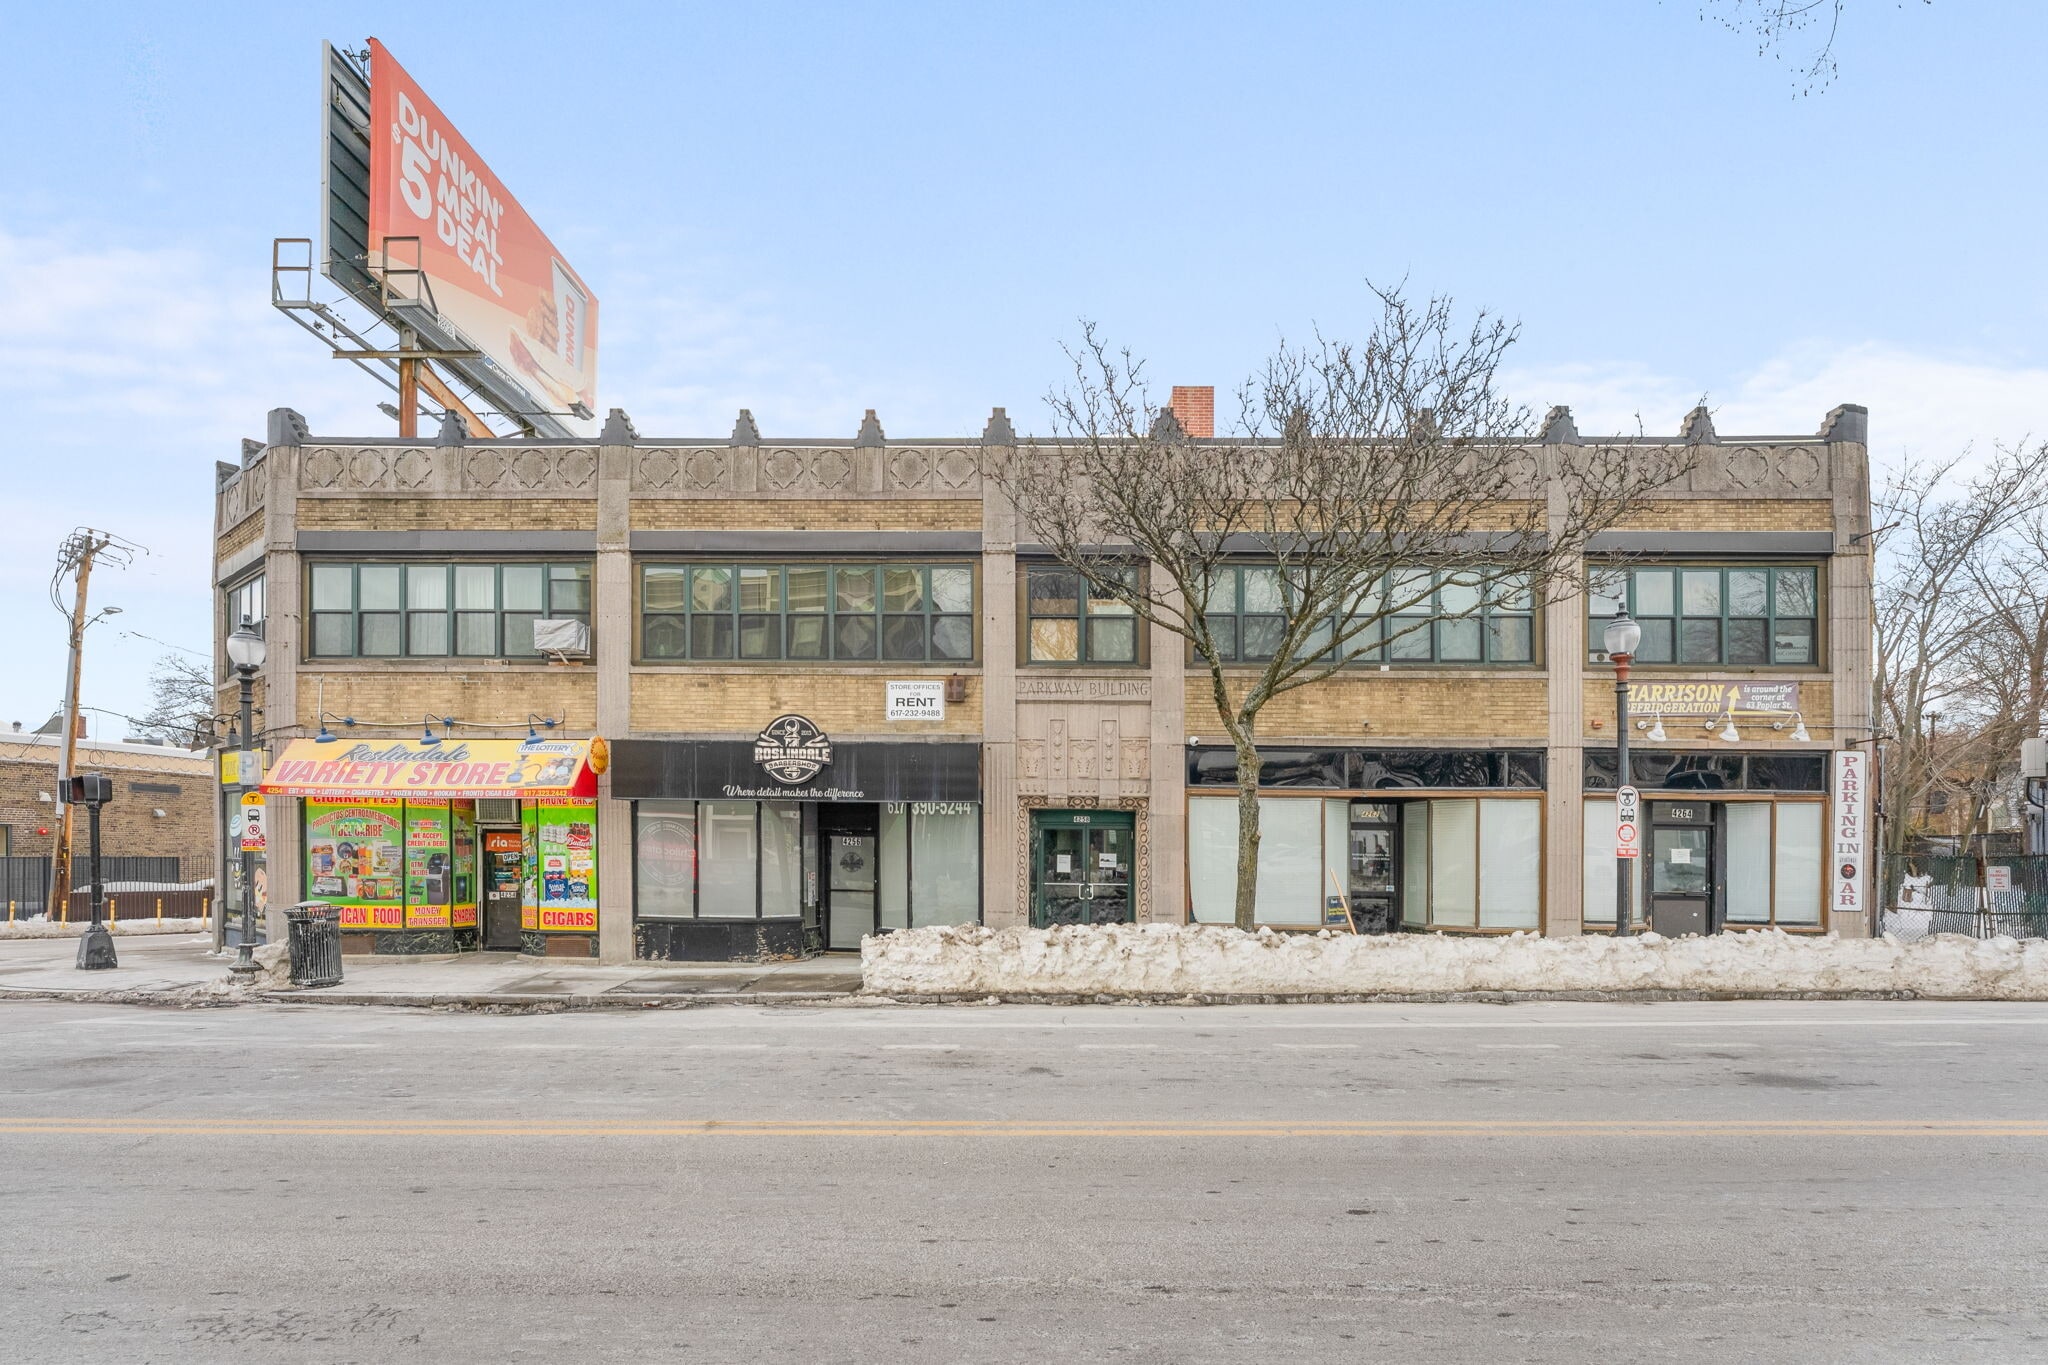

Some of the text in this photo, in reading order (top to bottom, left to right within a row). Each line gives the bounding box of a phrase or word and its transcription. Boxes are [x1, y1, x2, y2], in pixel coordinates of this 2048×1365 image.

[398, 91, 504, 229] DUNKIN'
[437, 173, 503, 265] MEAL
[437, 205, 503, 297] DEAL
[1019, 681, 1148, 696] PARKWAY BUILDING
[1743, 684, 1793, 693] is around the
[895, 697, 936, 707] RENT
[1757, 702, 1780, 711] Poplar
[1781, 701, 1793, 709] St.
[890, 709, 941, 717] 617-232-9488
[336, 743, 470, 762] Roslindale
[754, 747, 830, 762] ROSLINDALE
[768, 760, 817, 769] BARBERSHOP
[274, 760, 511, 786] VARIETY STORE
[321, 788, 346, 796] LOTTERY
[351, 789, 385, 797] CIGARETTES
[722, 784, 864, 800] Where detail makes the difference
[1841, 756, 1859, 839] PARKING
[887, 802, 971, 815] 617 390-5244
[1671, 809, 1693, 819] 4264
[312, 810, 343, 831] PRODUCTOS
[330, 824, 336, 837] Y
[490, 836, 508, 848] ria
[1837, 843, 1860, 854] IN
[341, 907, 367, 924] ICAN
[373, 907, 401, 924] FOOD
[414, 906, 441, 915] MONEY
[454, 908, 475, 923] SNACKS
[408, 917, 448, 926] TRANSFER
[543, 911, 594, 926] CIGARS
